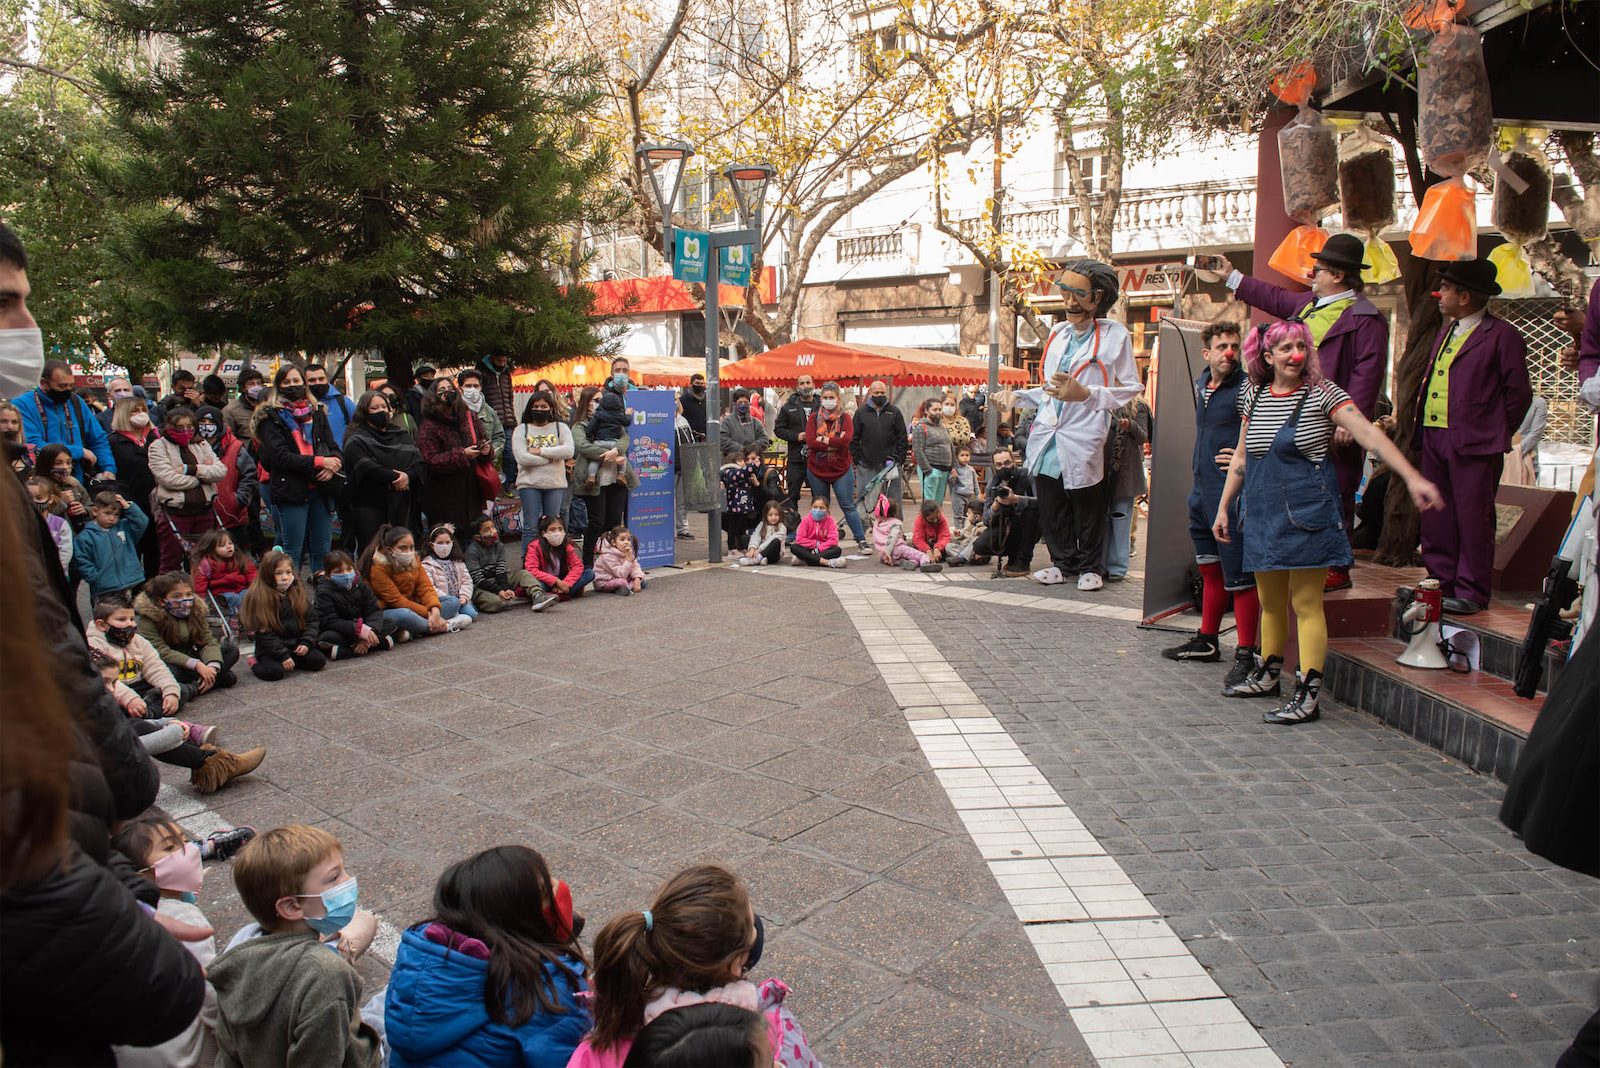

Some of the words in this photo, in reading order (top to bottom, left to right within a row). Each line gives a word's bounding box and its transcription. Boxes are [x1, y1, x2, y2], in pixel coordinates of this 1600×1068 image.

[680, 258, 702, 267] mendoza
[724, 264, 746, 272] mendoza
[796, 354, 815, 366] NN
